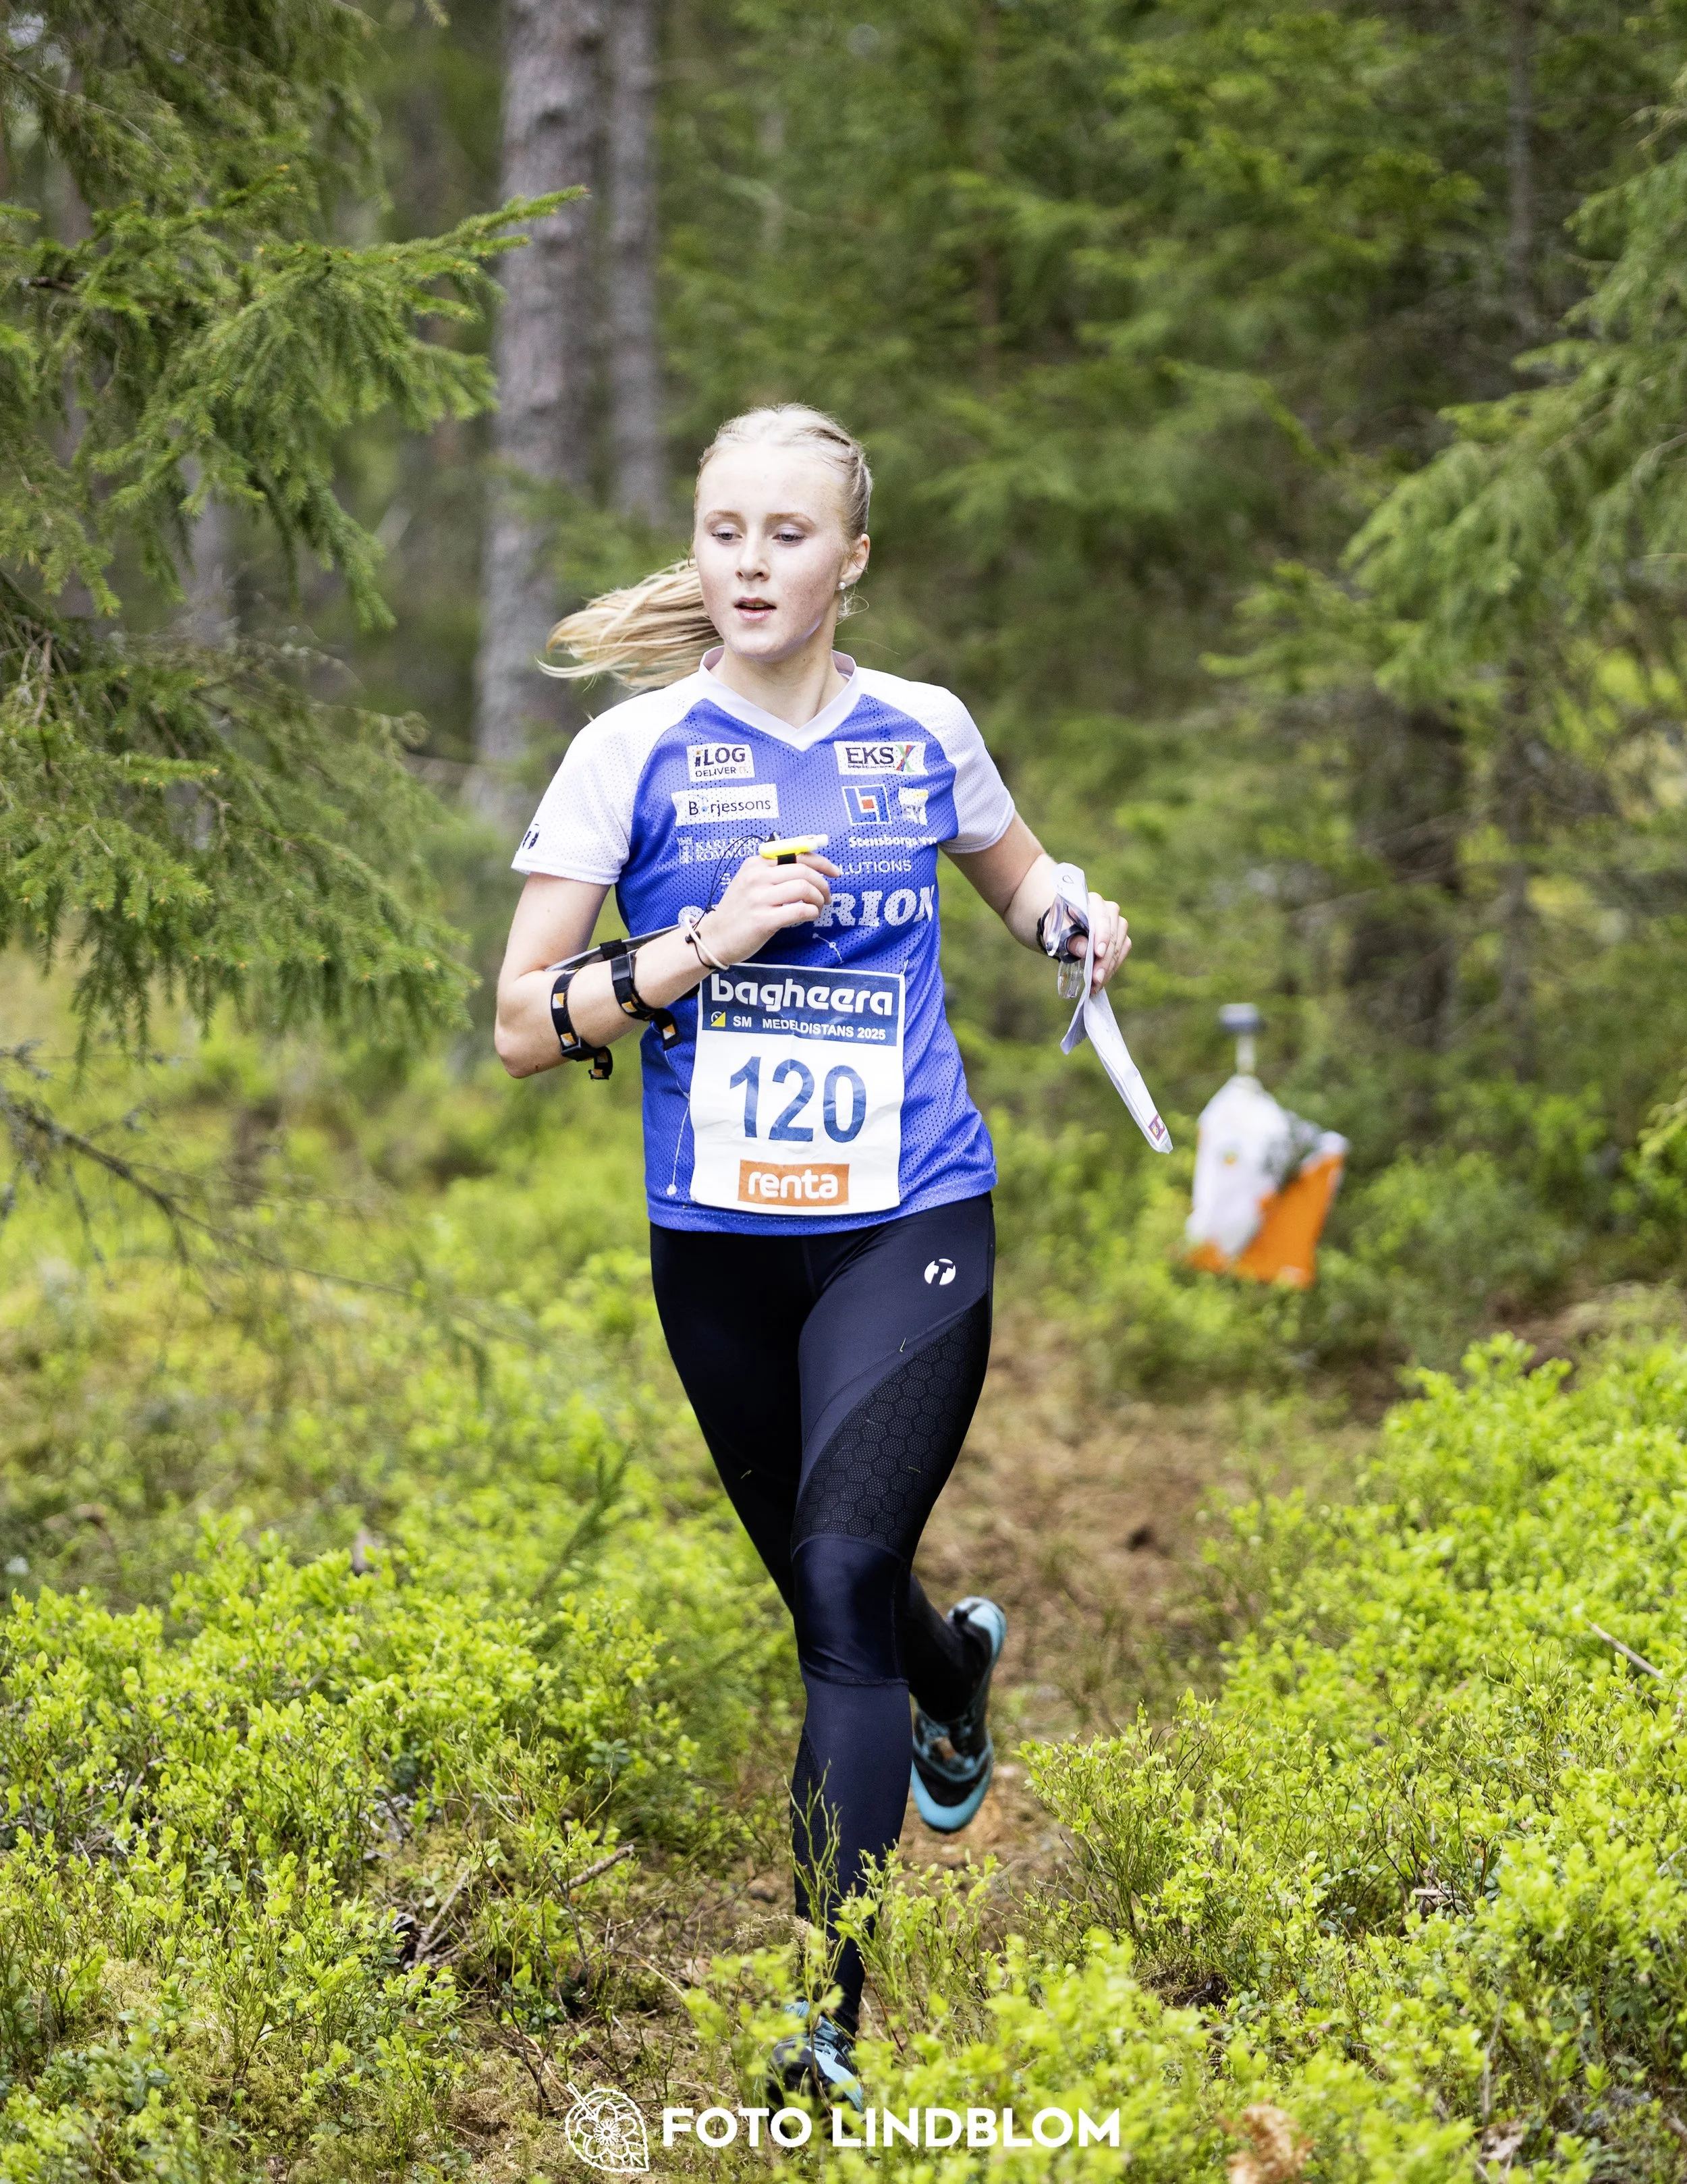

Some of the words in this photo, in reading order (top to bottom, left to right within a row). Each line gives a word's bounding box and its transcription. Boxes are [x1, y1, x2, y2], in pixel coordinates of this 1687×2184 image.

[694, 747, 746, 767] iLOG
[695, 767, 736, 777] DELIVER
[839, 859, 912, 875] LUTIONS
[783, 885, 935, 928] RION
[711, 973, 893, 1016] bagheera
[733, 1016, 752, 1027] SM
[763, 1018, 854, 1037] MEDELDISTANS
[857, 1027, 886, 1040] 2025
[729, 1056, 866, 1143] 120
[748, 1168, 839, 1199] renta
